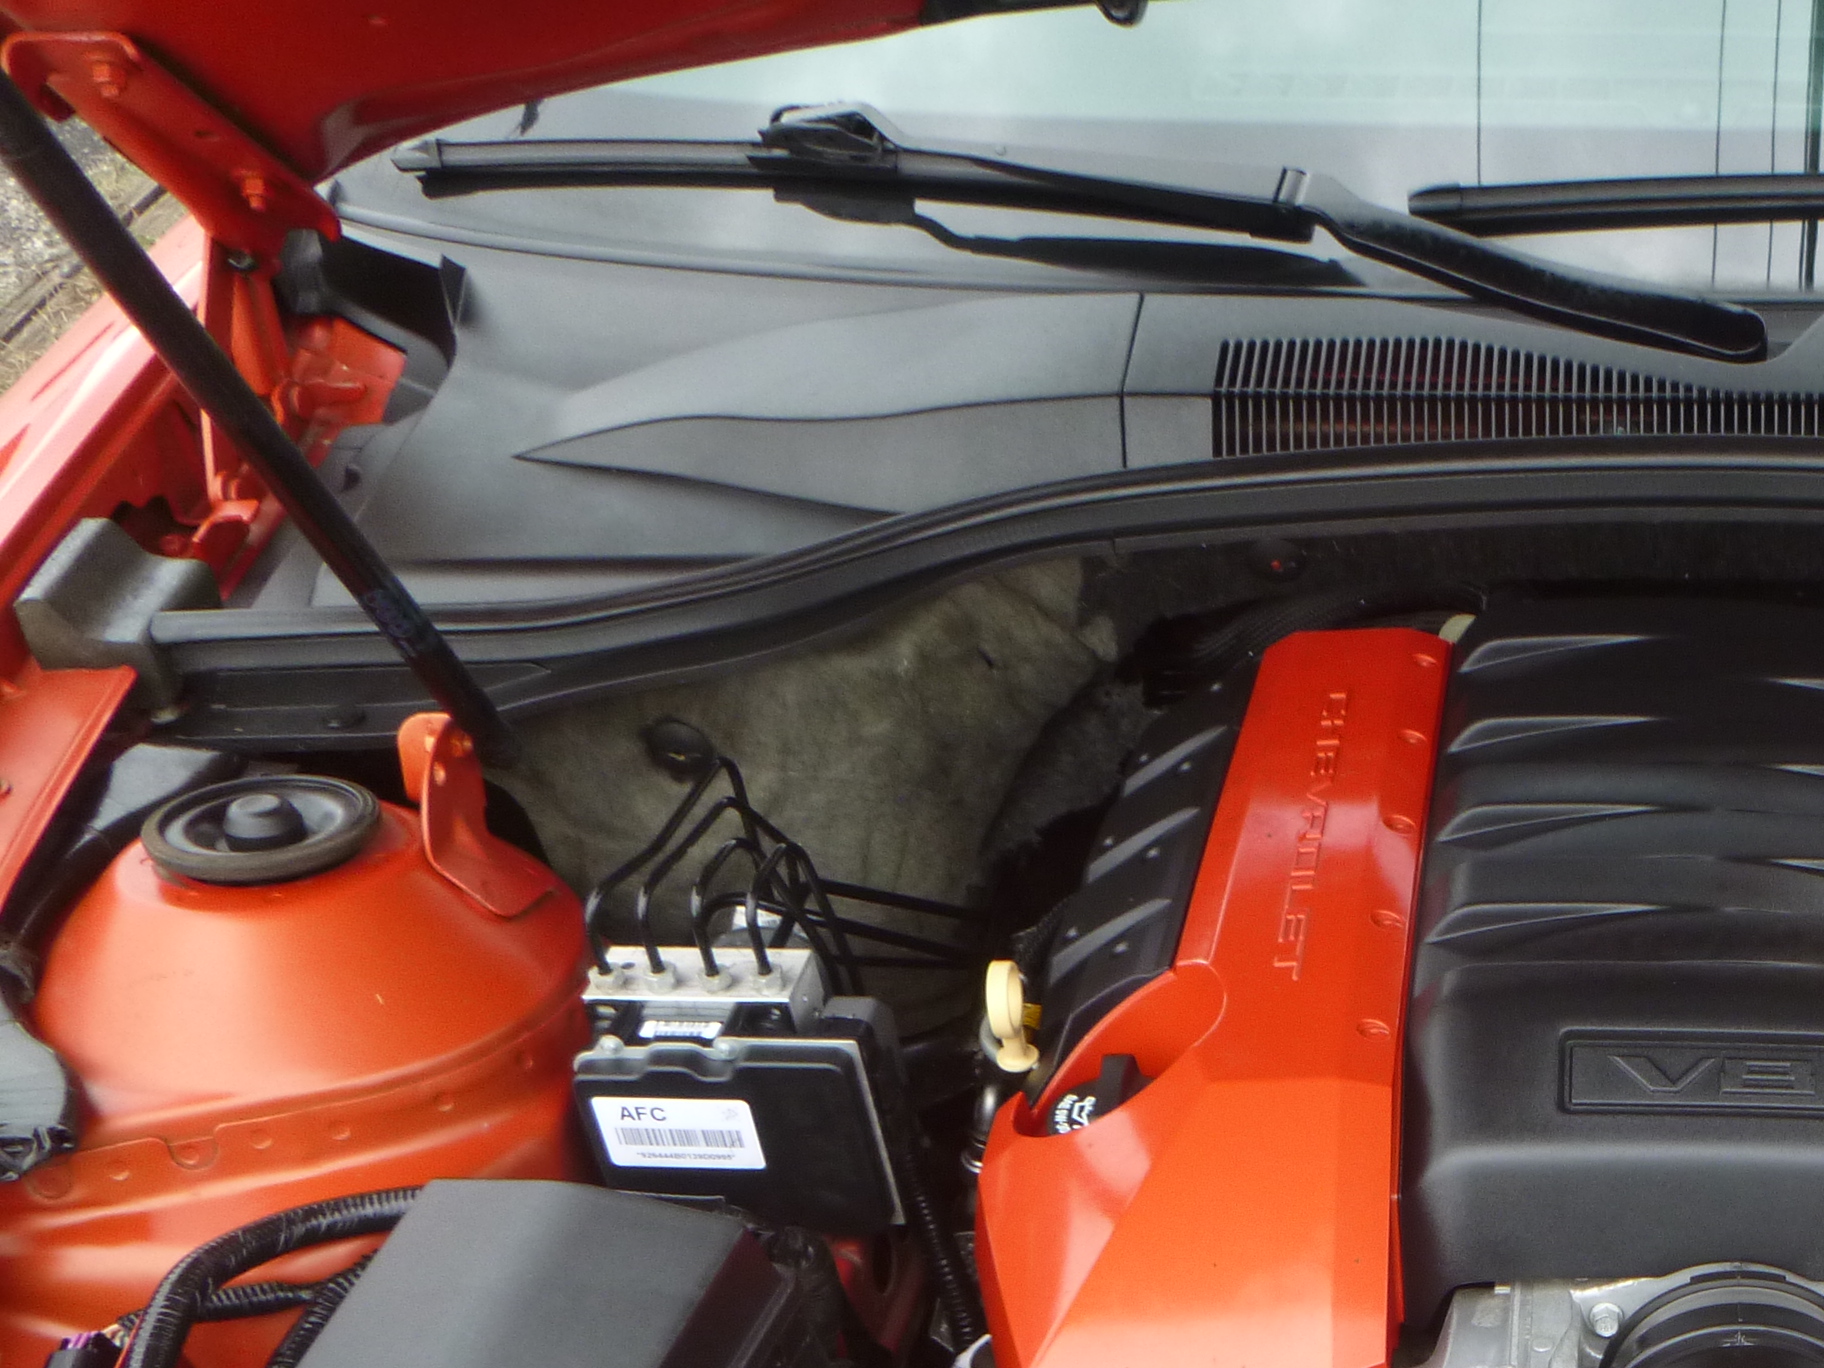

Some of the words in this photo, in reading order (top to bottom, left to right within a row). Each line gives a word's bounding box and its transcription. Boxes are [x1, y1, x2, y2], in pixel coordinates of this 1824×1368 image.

[1273, 692, 1347, 980] CHEVROLET
[1606, 1054, 1816, 1096] V8
[620, 1106, 667, 1121] AFC
